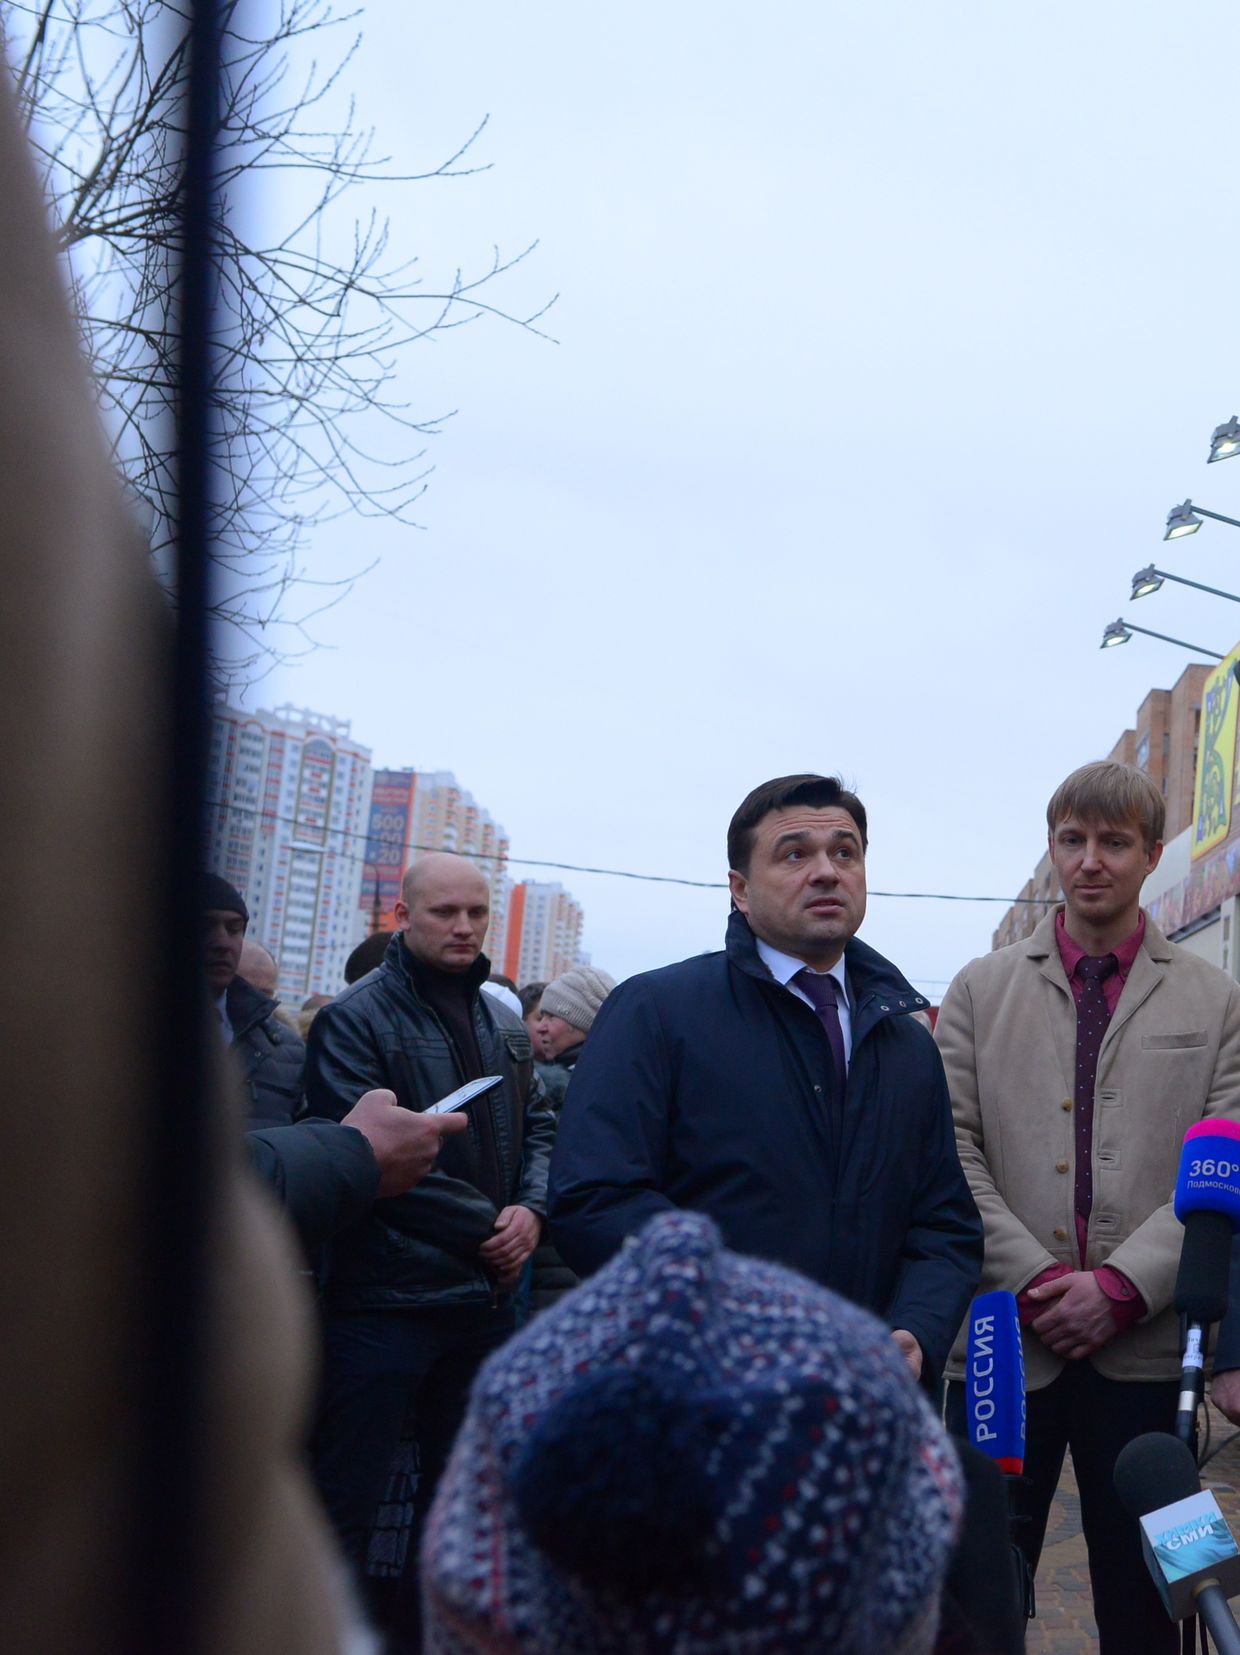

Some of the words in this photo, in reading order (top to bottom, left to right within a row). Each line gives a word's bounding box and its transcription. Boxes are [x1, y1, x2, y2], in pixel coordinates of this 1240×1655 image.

[1188, 1159, 1240, 1178] 360°
[973, 1315, 998, 1443] РОССИЯ
[1166, 1524, 1214, 1550] СМИ
